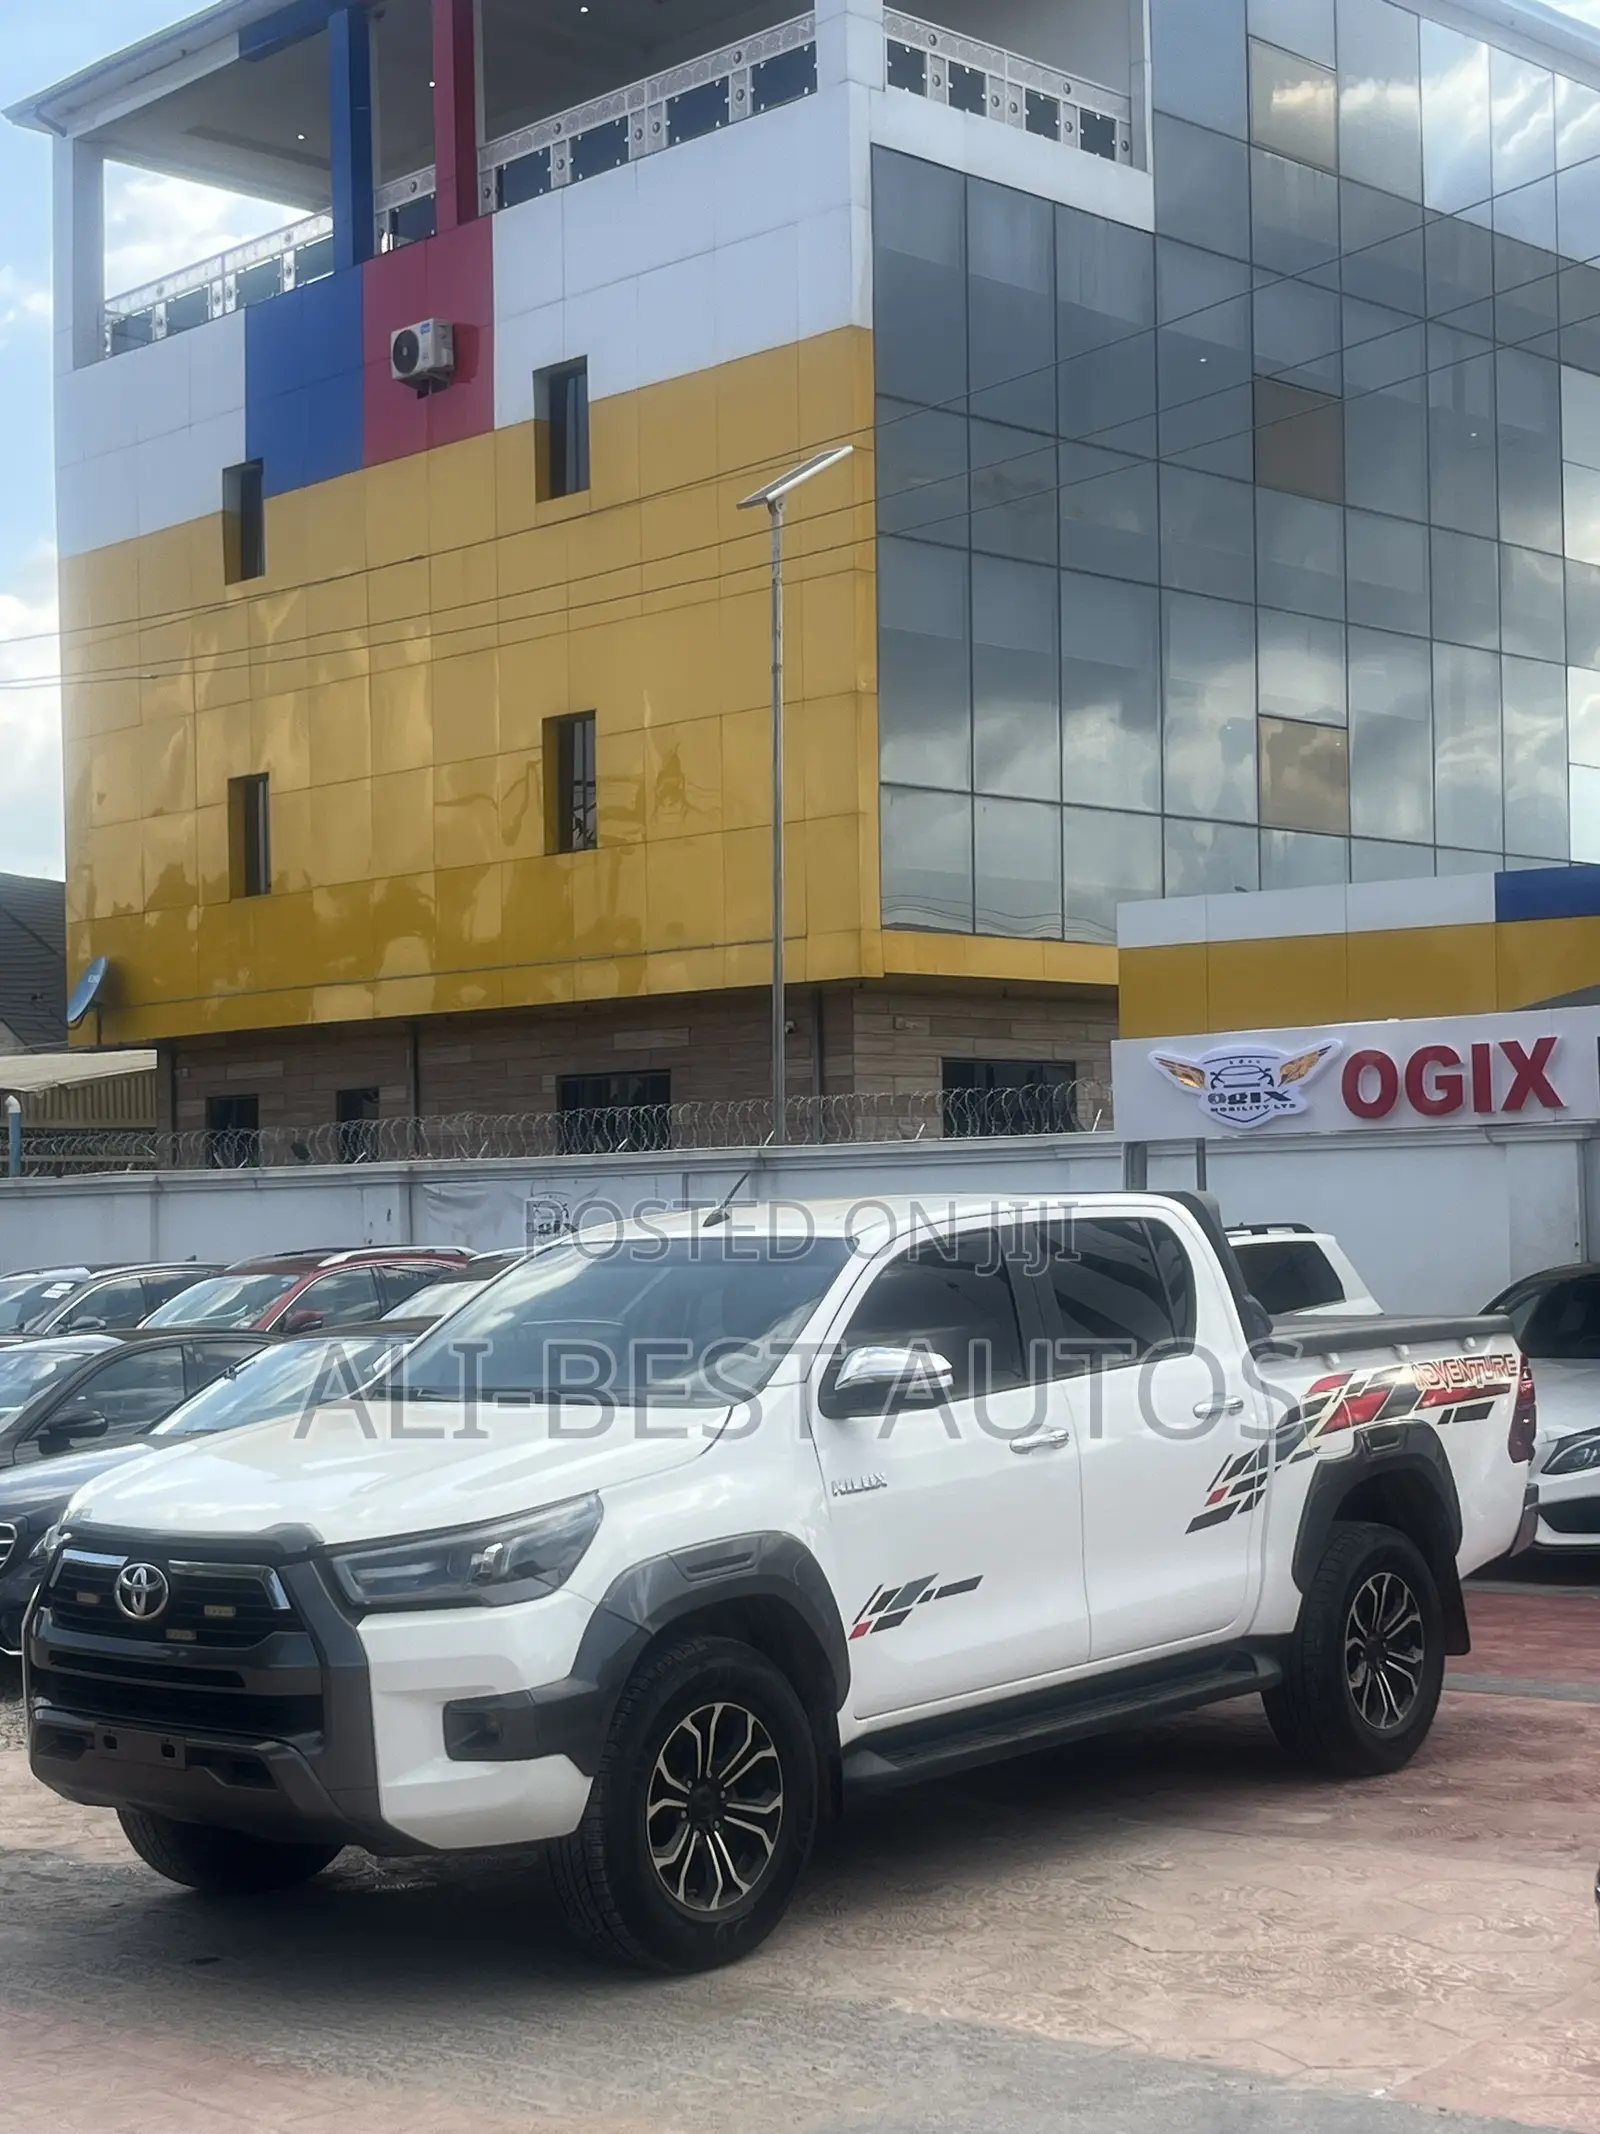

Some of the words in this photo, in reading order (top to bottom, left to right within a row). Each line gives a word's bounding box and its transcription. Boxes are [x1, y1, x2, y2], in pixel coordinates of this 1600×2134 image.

[1342, 1036, 1564, 1119] OGIX
[1411, 1353, 1518, 1389] ADVENTURE
[831, 1472, 888, 1497] HILUX
